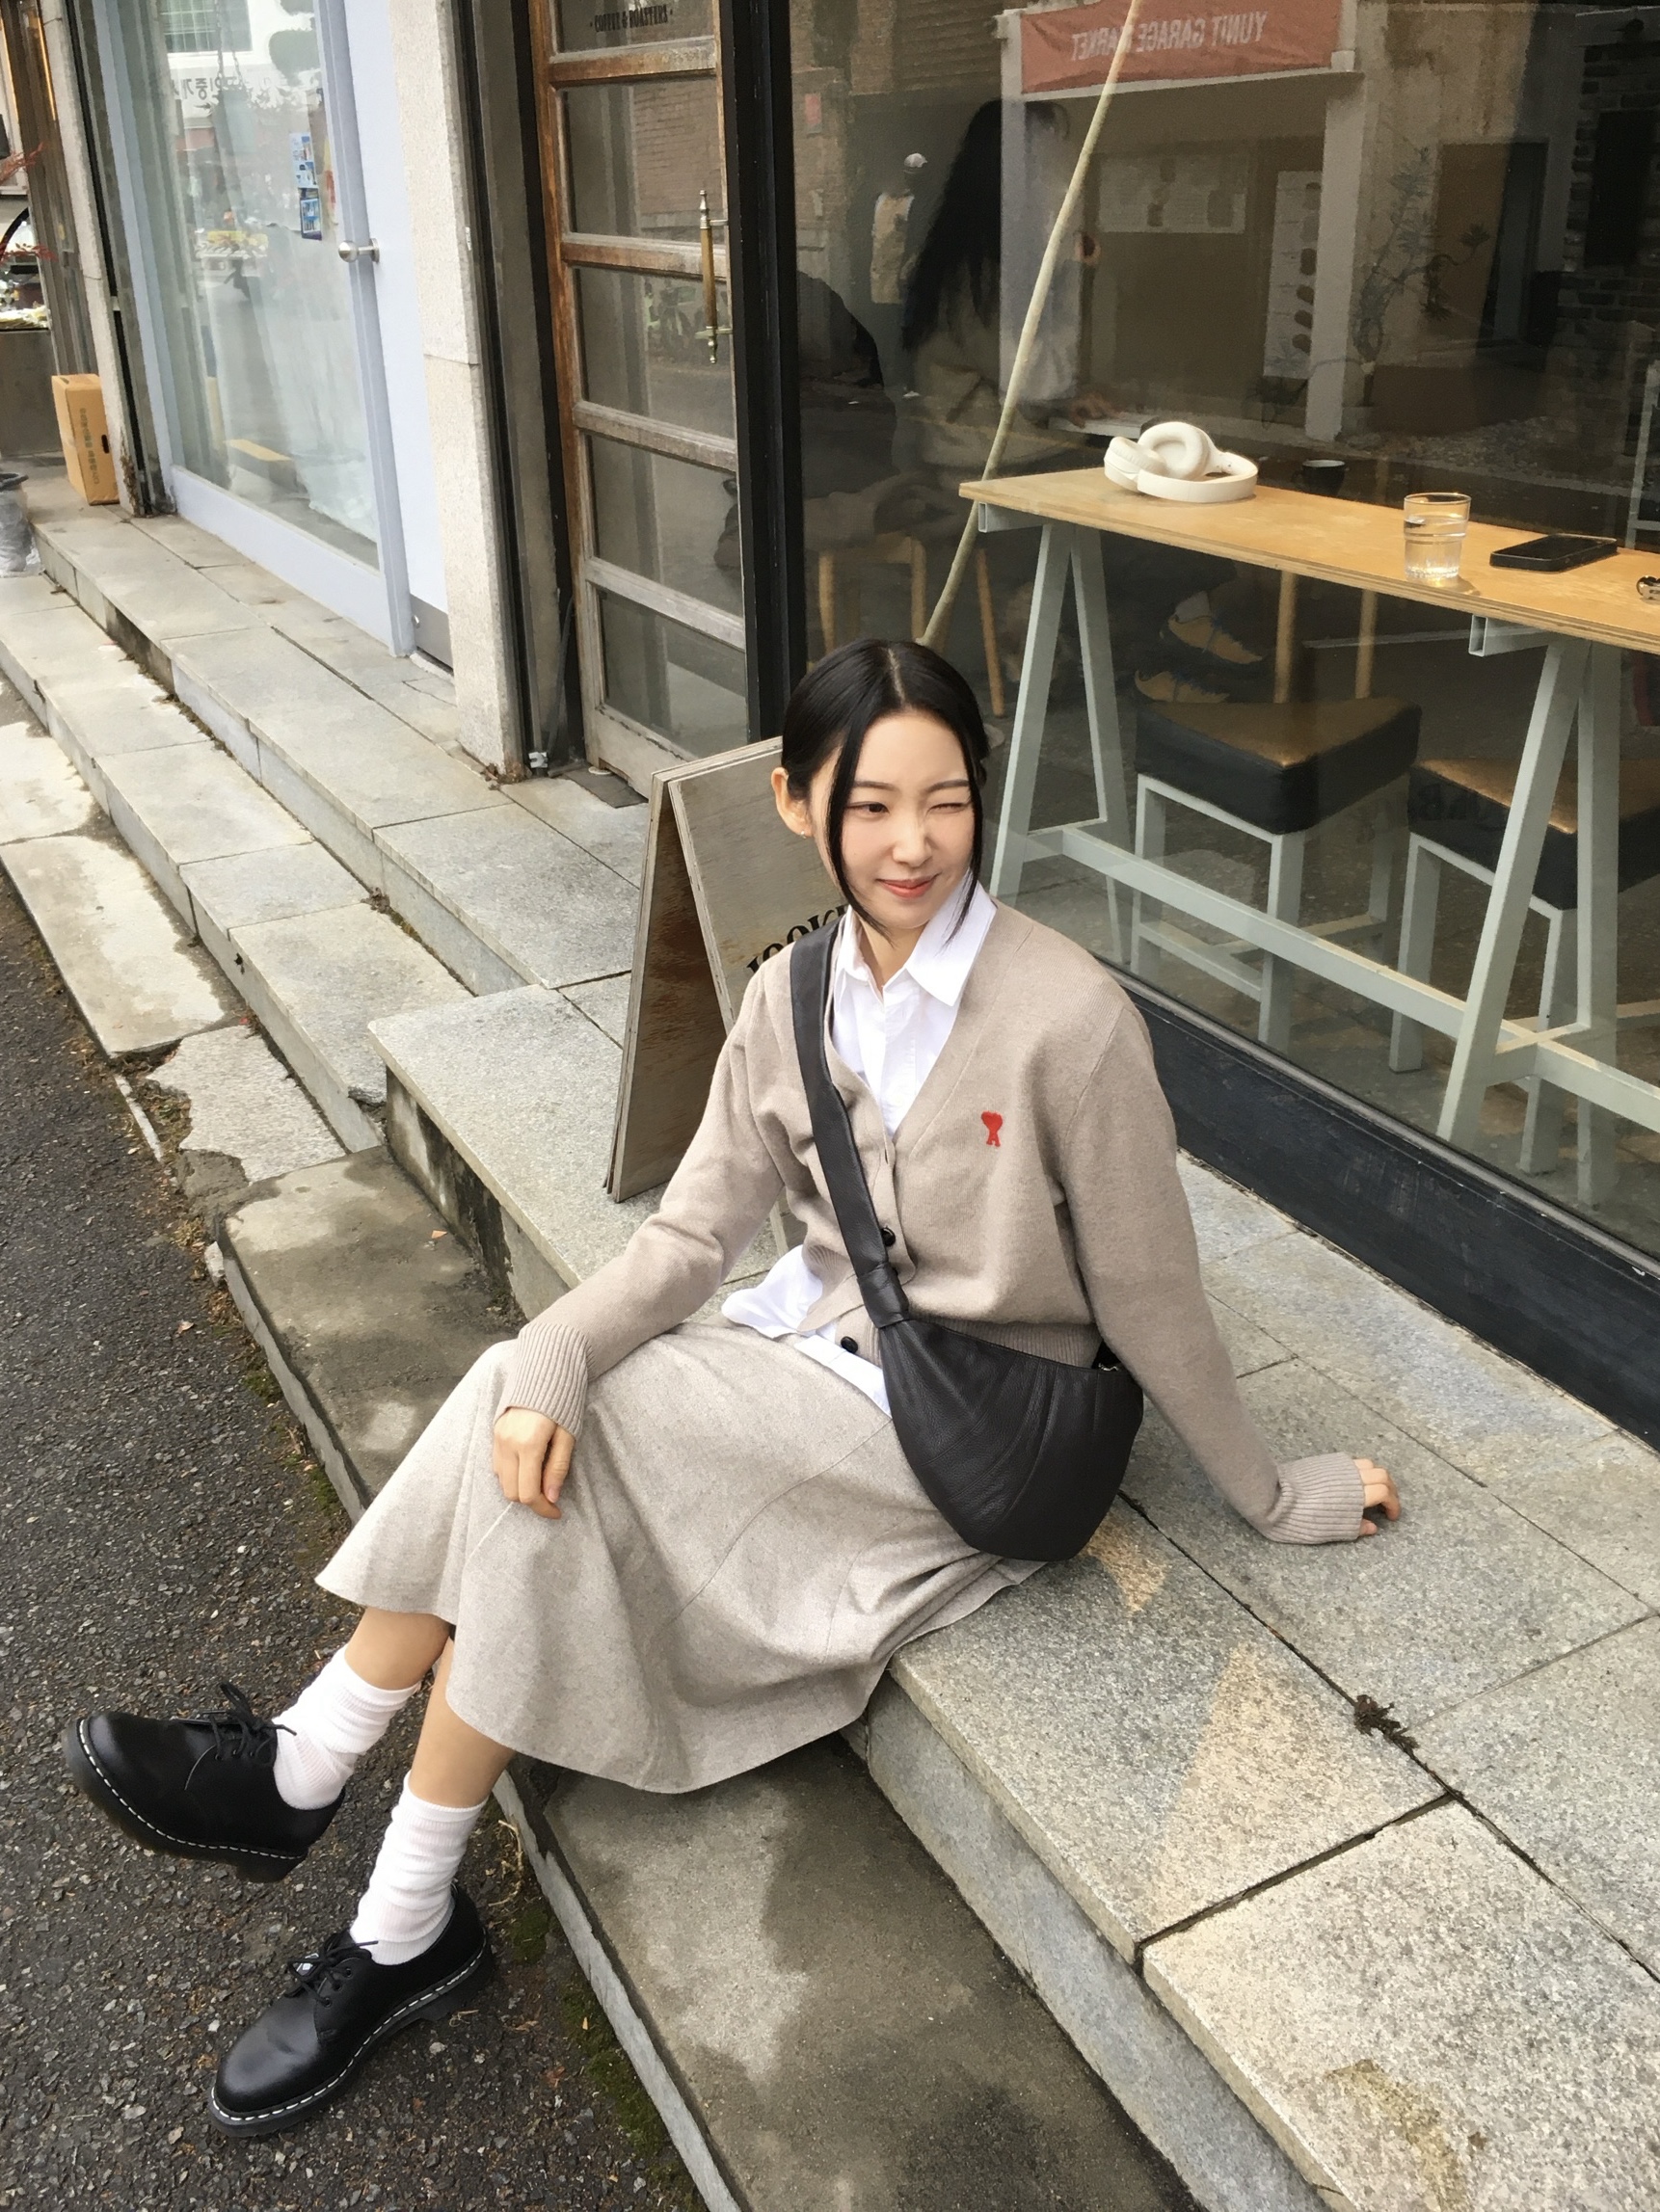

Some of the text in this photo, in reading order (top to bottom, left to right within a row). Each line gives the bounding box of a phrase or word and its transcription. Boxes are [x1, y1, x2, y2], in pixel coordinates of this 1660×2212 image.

[595, 5, 668, 32] COFFEE & ROASTERS
